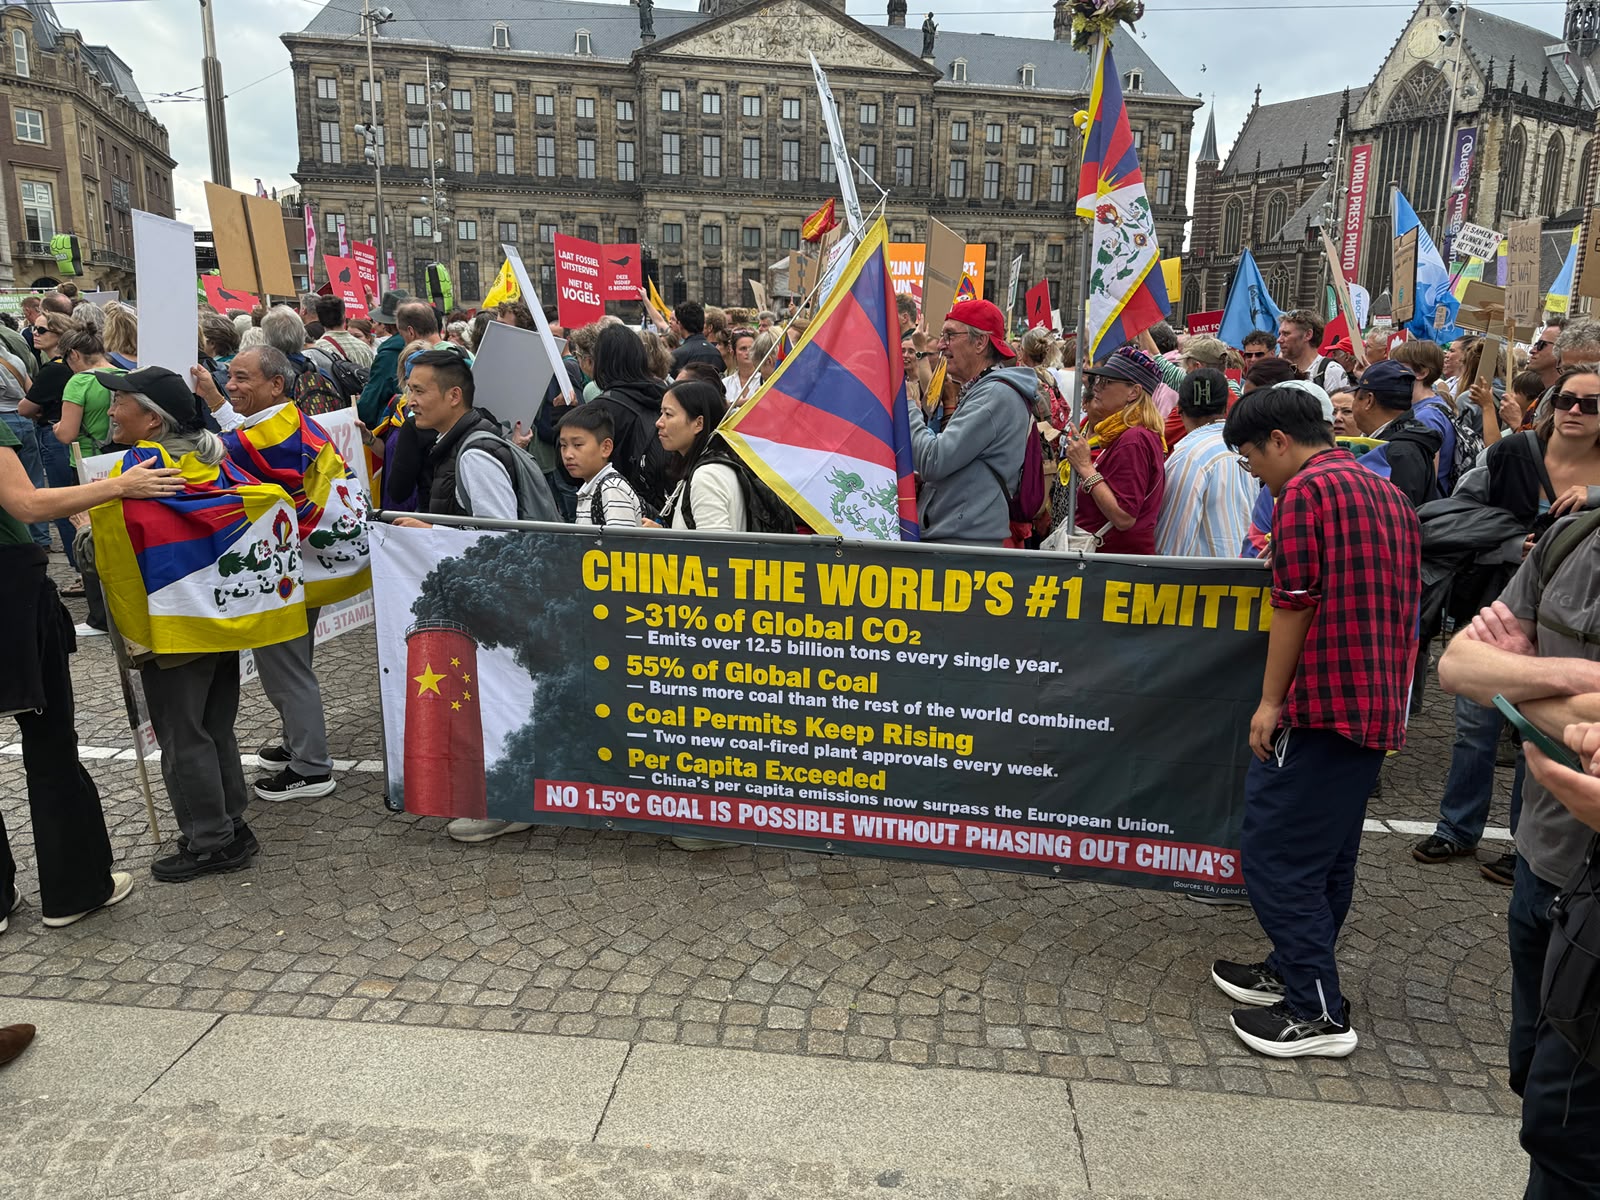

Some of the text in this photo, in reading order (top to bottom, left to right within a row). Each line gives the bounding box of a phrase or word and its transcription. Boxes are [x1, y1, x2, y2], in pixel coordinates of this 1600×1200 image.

[1343, 151, 1367, 270] WORLD PRESS PHOTO
[358, 271, 375, 281] OGELS
[558, 249, 600, 268] LAAT FOSSIEL
[561, 261, 599, 277] UITSTERVEN
[561, 286, 600, 306] VOGELS
[568, 278, 593, 291] NIET DE
[1193, 325, 1210, 333] LAAT
[582, 550, 718, 597] CHINA:
[729, 558, 805, 603] THE
[1025, 576, 1082, 619] #1
[626, 603, 707, 630] >31%
[714, 609, 745, 632] of
[752, 610, 853, 640] Global
[648, 630, 696, 647] Emits
[702, 638, 740, 650] over
[746, 637, 781, 653] 12.5
[788, 640, 844, 658] billion
[850, 645, 890, 661] tons
[896, 651, 948, 669] every
[954, 654, 1010, 671] single
[1016, 659, 1063, 674] year.
[627, 655, 877, 693] 55% of Global Coal
[650, 680, 697, 696] Burns
[703, 687, 744, 700] more
[749, 690, 783, 704] coal
[788, 692, 826, 707] than
[832, 695, 859, 709] the
[865, 700, 899, 713] rest
[904, 701, 922, 715] of
[927, 703, 955, 717] the
[960, 707, 1012, 723] world
[1018, 713, 1114, 731] combined.
[627, 703, 973, 755] Coal Permits Keep Rising
[628, 749, 885, 790] Per Capita Exceeded
[653, 729, 686, 744] Two
[691, 736, 725, 747] new
[730, 738, 808, 755] coal-fired
[814, 744, 857, 759] plant
[862, 751, 948, 768] approvals
[953, 759, 1002, 776] every
[1008, 764, 1058, 777] week.
[547, 785, 578, 807] NO
[647, 795, 703, 819] GOAL
[711, 801, 731, 822] IS
[739, 803, 845, 834] POSSIBLE
[852, 815, 959, 845] WITHOUT
[966, 826, 1071, 858] PHASING
[1080, 839, 1129, 864] OUT
[715, 781, 741, 792] per
[745, 784, 794, 797] capita
[799, 788, 878, 805] emissions
[884, 797, 917, 808] now
[923, 801, 989, 815] surpass
[994, 805, 1022, 819] the
[1028, 808, 1111, 828] European
[1118, 817, 1174, 834] Union.
[1173, 881, 1203, 891] (Sources:
